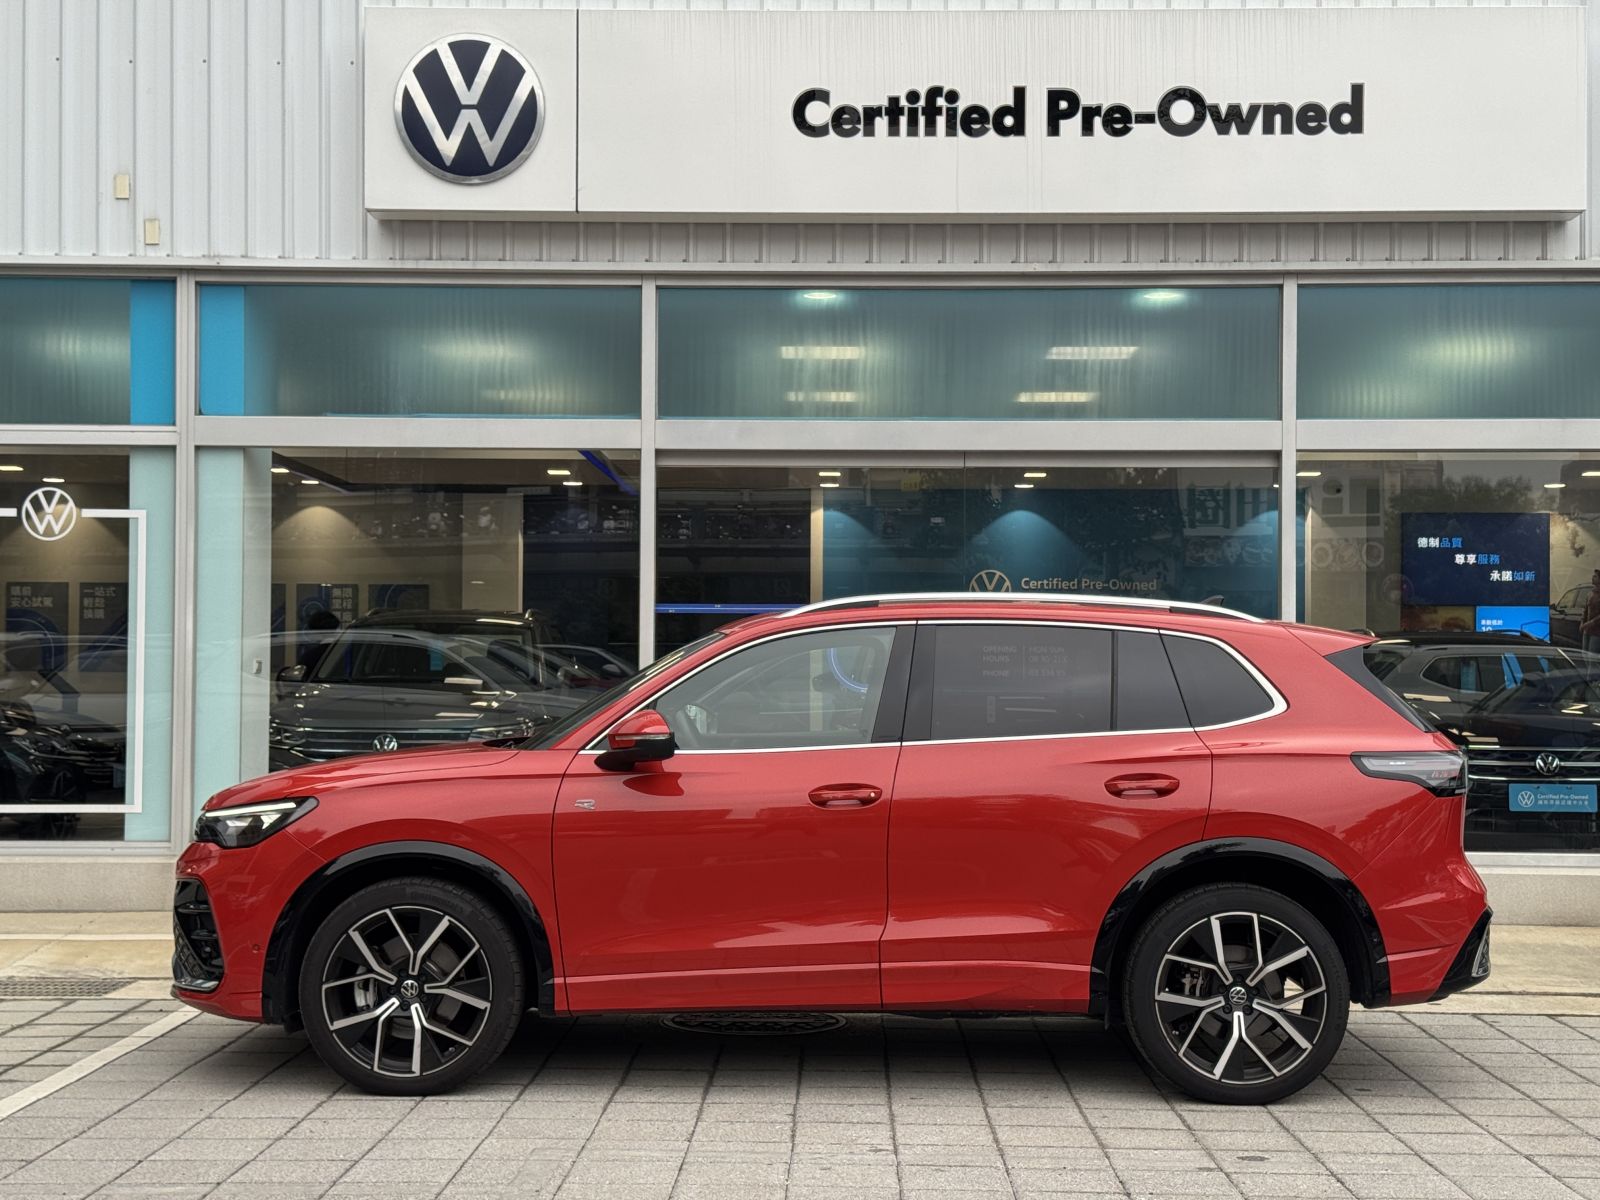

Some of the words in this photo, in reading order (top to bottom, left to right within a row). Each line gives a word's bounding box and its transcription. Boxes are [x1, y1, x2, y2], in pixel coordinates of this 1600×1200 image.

[394, 33, 546, 186] VW
[792, 84, 1027, 138] Certified
[1046, 82, 1365, 138] Pre-Owned
[22, 487, 77, 541] VW
[1020, 577, 1078, 590] Certified
[1081, 578, 1157, 591] Pre-Owned
[1454, 553, 1500, 565] 尊享服務
